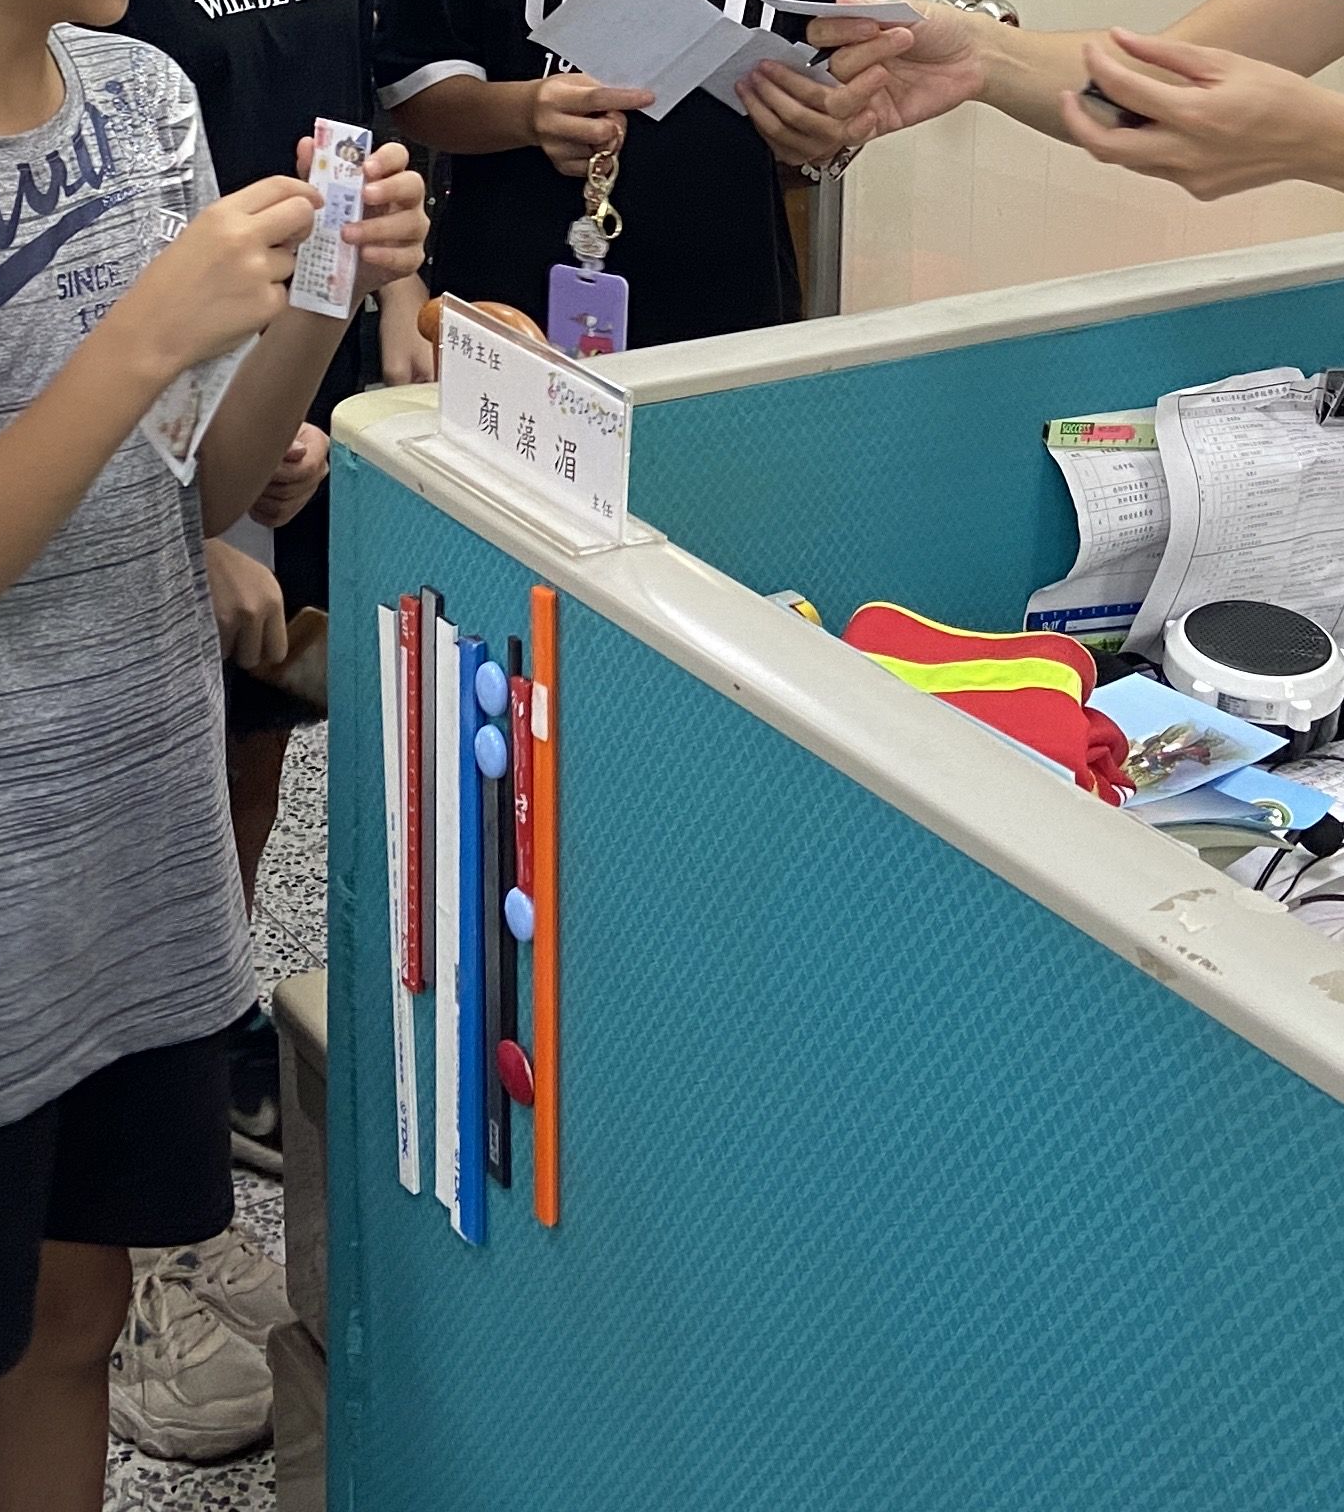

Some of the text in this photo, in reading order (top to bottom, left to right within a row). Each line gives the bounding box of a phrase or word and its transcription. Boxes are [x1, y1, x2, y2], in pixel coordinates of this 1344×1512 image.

[447, 325, 503, 371] 學務主任
[477, 392, 577, 482] 顏藻湄
[591, 493, 614, 519] 主任
